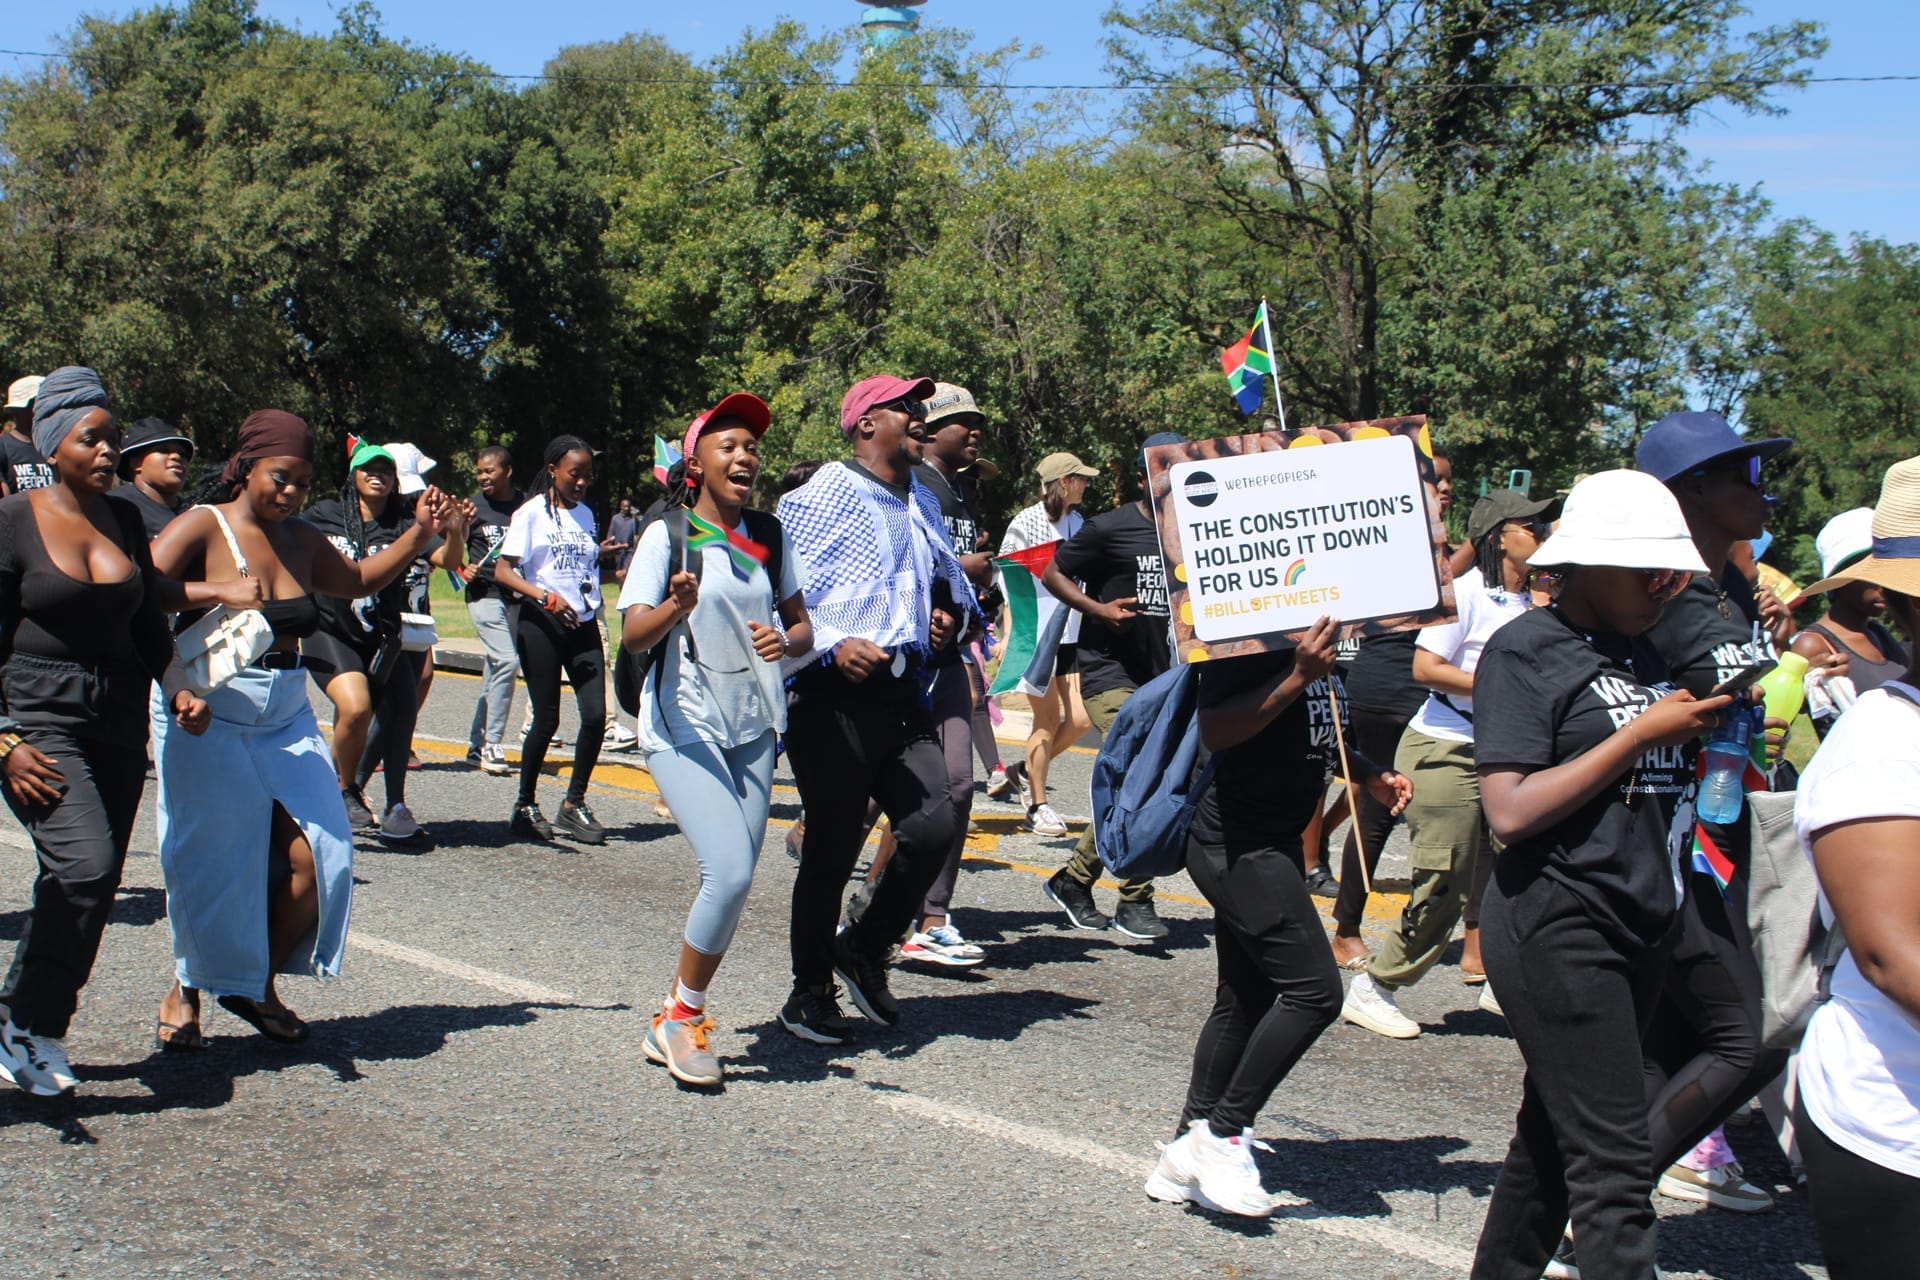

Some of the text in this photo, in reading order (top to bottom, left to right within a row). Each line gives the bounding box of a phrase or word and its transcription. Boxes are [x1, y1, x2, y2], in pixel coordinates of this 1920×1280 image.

[1189, 495, 1414, 542] THE CONSTITUTION'S
[569, 530, 588, 543] THE
[1195, 525, 1388, 569] HOLDING IT DOWN
[551, 543, 588, 559] PEOPLE
[553, 556, 581, 570] WALK
[1199, 567, 1279, 596] FOR US
[1203, 586, 1341, 619] #BILLOFTWEETS
[1634, 743, 1684, 769] ALK
